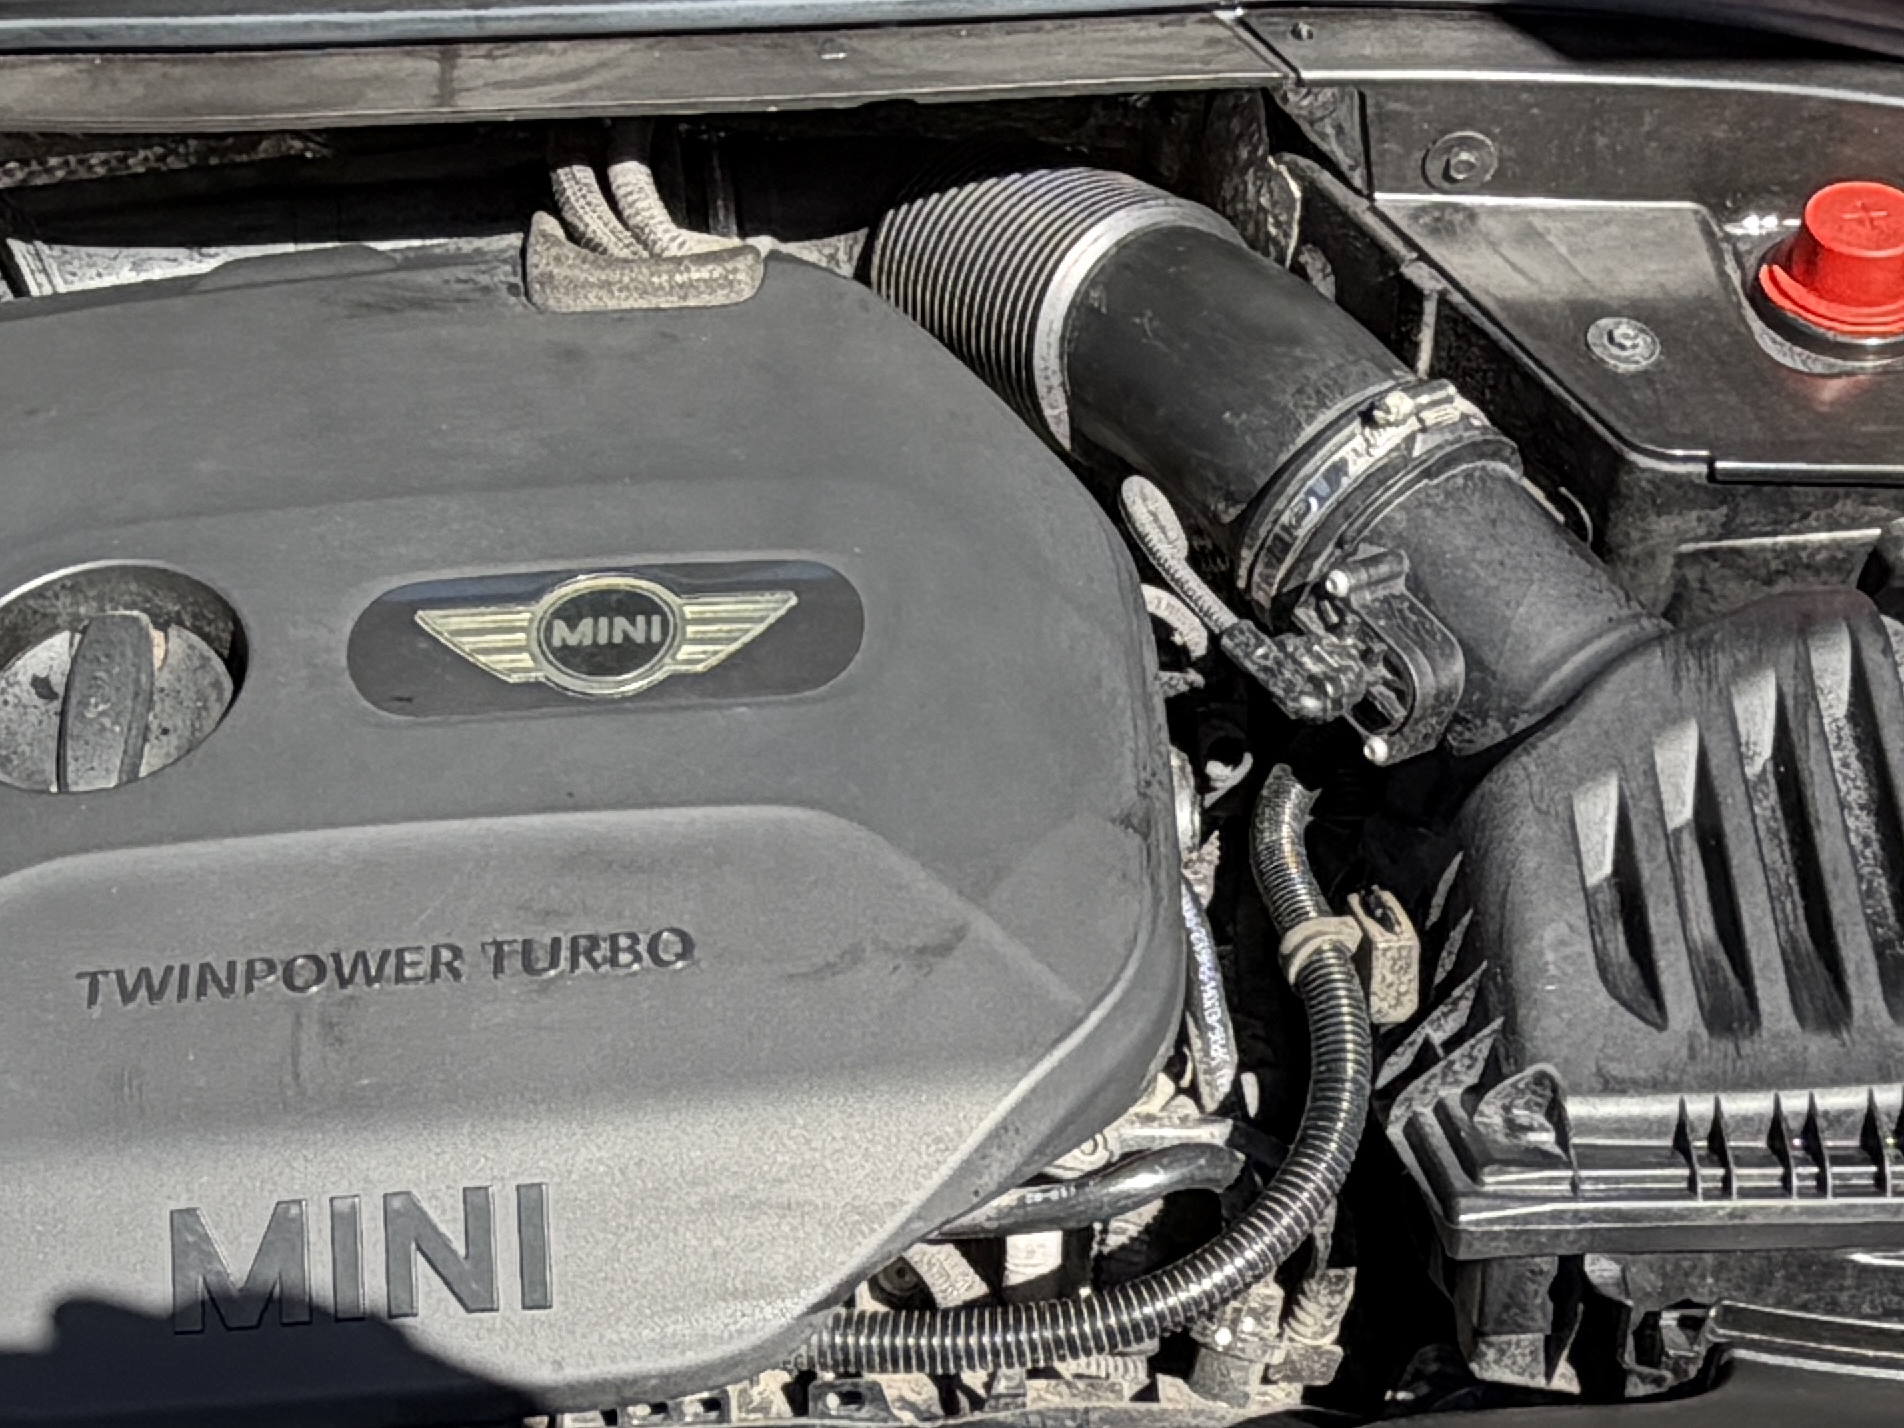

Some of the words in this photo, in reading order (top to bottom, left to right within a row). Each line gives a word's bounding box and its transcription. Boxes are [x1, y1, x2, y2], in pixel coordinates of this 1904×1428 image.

[552, 614, 663, 649] MINI
[75, 942, 464, 1010] TWINPOWER
[480, 926, 697, 981] TURBO
[169, 1182, 554, 1335] MINI
